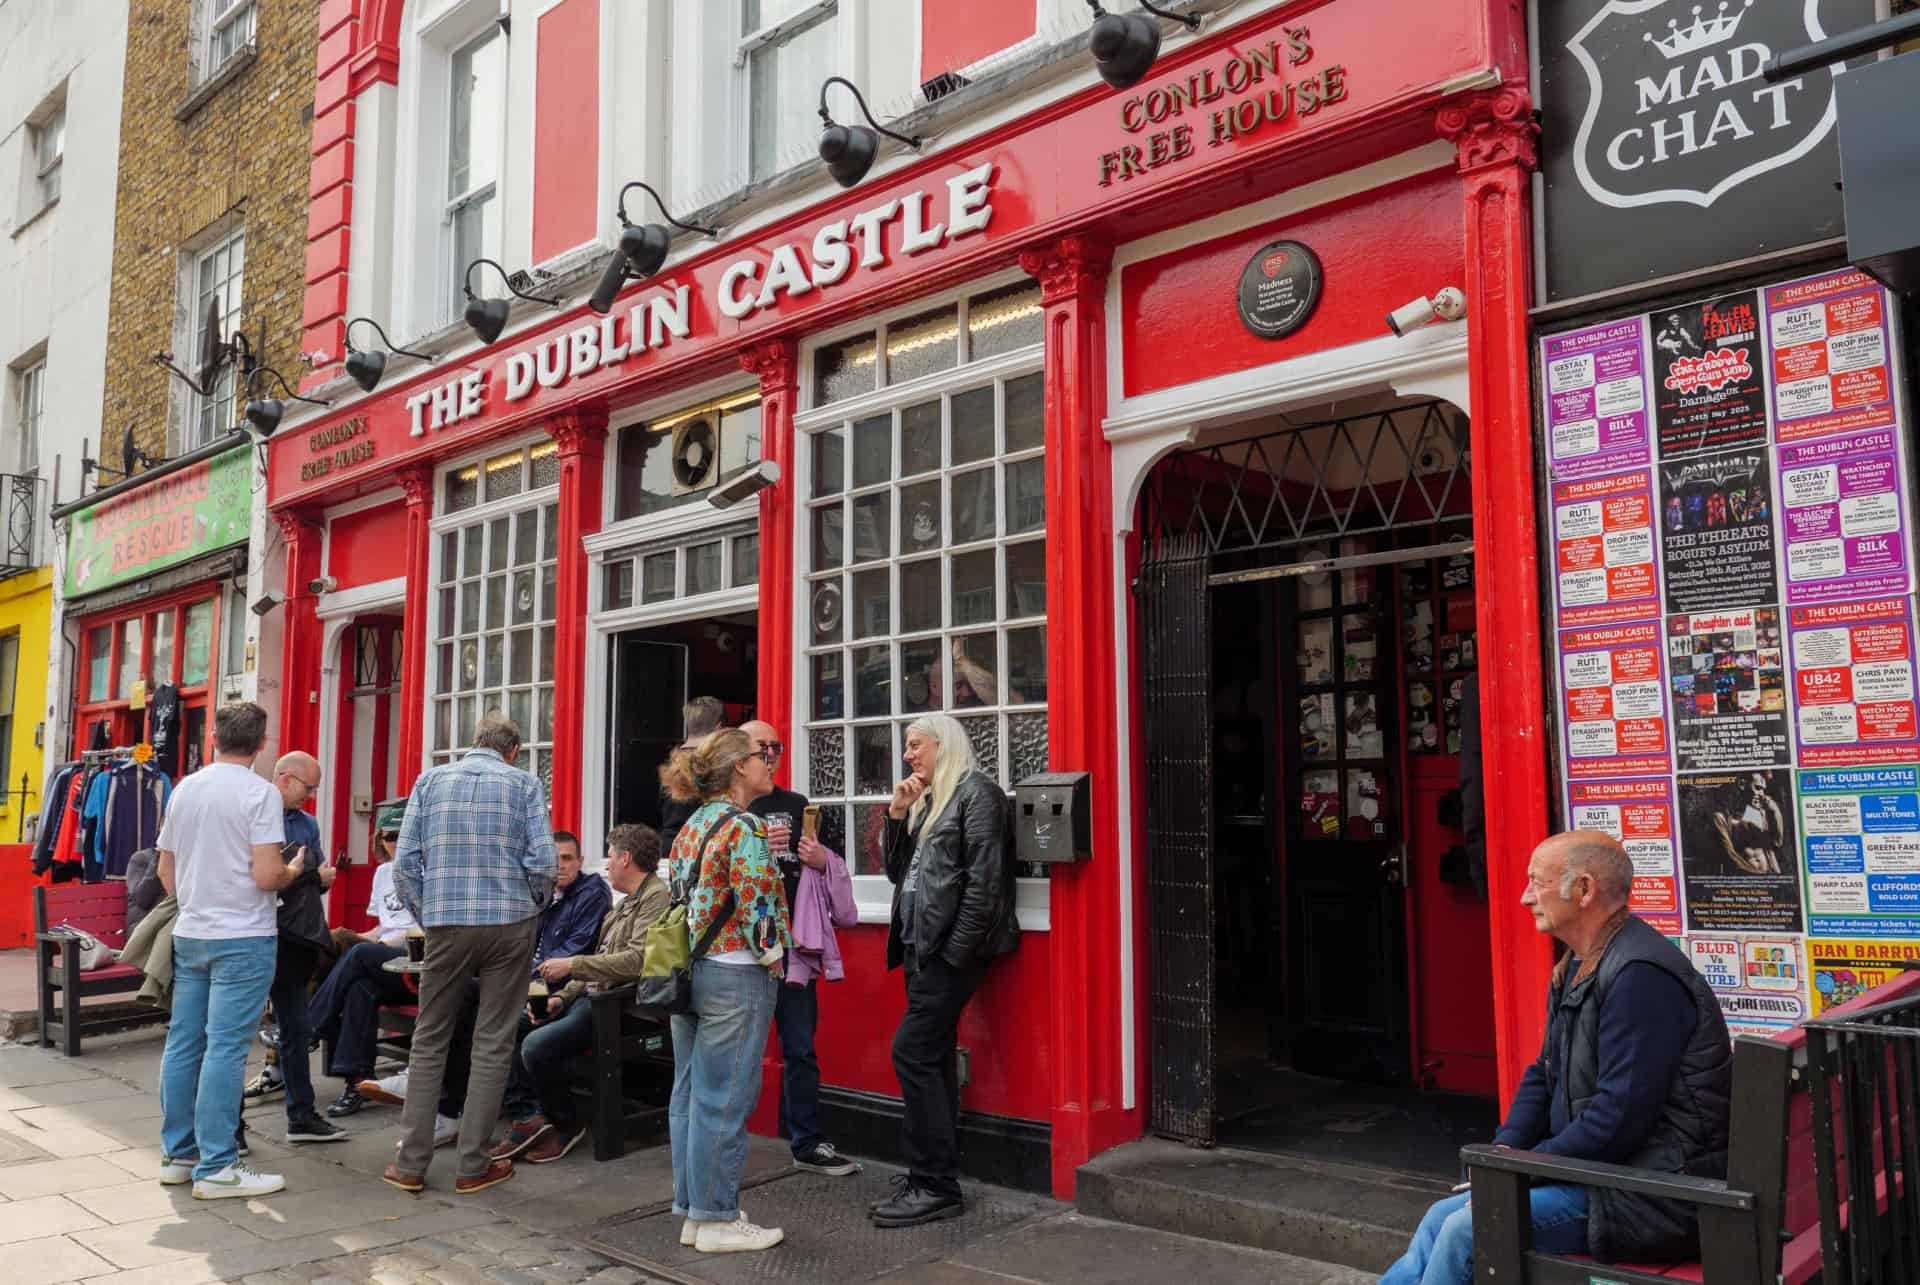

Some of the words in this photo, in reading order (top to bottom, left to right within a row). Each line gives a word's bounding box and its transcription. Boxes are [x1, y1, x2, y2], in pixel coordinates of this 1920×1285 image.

[1119, 25, 1314, 133] CONLON'S
[1634, 42, 1771, 114] MAD
[1098, 122, 1195, 187] FREE
[1208, 64, 1348, 147] HOUSE
[1606, 79, 1803, 171] CHAT
[1258, 277, 1293, 291] Madness
[1786, 286, 1801, 297] THE
[1806, 278, 1840, 294] DUBLIN
[405, 367, 486, 437] THE
[504, 285, 691, 402] DUBLIN
[717, 162, 993, 320] CASTLE
[1704, 317, 1756, 340] LEAVES
[1561, 338, 1576, 349] THE
[1577, 330, 1607, 345] DUBLIN
[1608, 324, 1637, 337] CASTLE
[1832, 338, 1855, 350] DROP
[1857, 334, 1880, 345] PINK
[1554, 359, 1588, 373] GESTALT
[1779, 383, 1829, 398] STRAIGHTEN
[1609, 418, 1635, 431] BILK
[1797, 447, 1816, 457] THE
[1817, 441, 1853, 454] DUBLIN
[1855, 434, 1890, 447] CASTLE
[1789, 471, 1830, 482] GESTALT
[1568, 484, 1583, 494] THE
[1585, 480, 1614, 491] DUBLIN
[1616, 475, 1646, 486] CASTLE
[1569, 508, 1591, 519] RUT!
[113, 514, 191, 568] RESCUE
[1607, 536, 1628, 546] DROP
[1665, 534, 1696, 549] THE
[1698, 524, 1769, 545] THREATS
[1667, 546, 1716, 562] ROGUE'S
[1718, 540, 1770, 556] ASYLUM
[1857, 540, 1888, 553] BILK
[1562, 575, 1604, 587] STRAIGHTEN
[1808, 608, 1826, 618] THE
[1829, 603, 1865, 615] DUBLIN
[1867, 600, 1903, 611] CASTLE
[1577, 633, 1591, 642] THE
[1593, 629, 1624, 640] DUBLIN
[1625, 626, 1655, 636] CASTLE
[1577, 657, 1599, 667] RUT!
[1856, 668, 1882, 678] CHRIS
[1615, 688, 1637, 697] DROP
[1816, 774, 1837, 784] THE
[1840, 772, 1875, 783] DUBLIN
[1877, 770, 1914, 780] CASTLE
[1585, 786, 1601, 794] THE
[1603, 785, 1633, 793] DUBLIN
[1635, 783, 1665, 792] CASTLE
[1828, 801, 1857, 809] LOUNGE
[1586, 811, 1608, 821] RUT!
[1867, 844, 1896, 852] GREEN
[1813, 881, 1839, 889] SHARP
[1846, 920, 1878, 928] advance
[1880, 920, 1907, 928] tickets
[1695, 943, 1736, 955] BLUR
[1812, 944, 1847, 958] DAN
[1709, 955, 1722, 965] Vs
[1705, 965, 1728, 974] THE
[1706, 975, 1737, 987] URE
